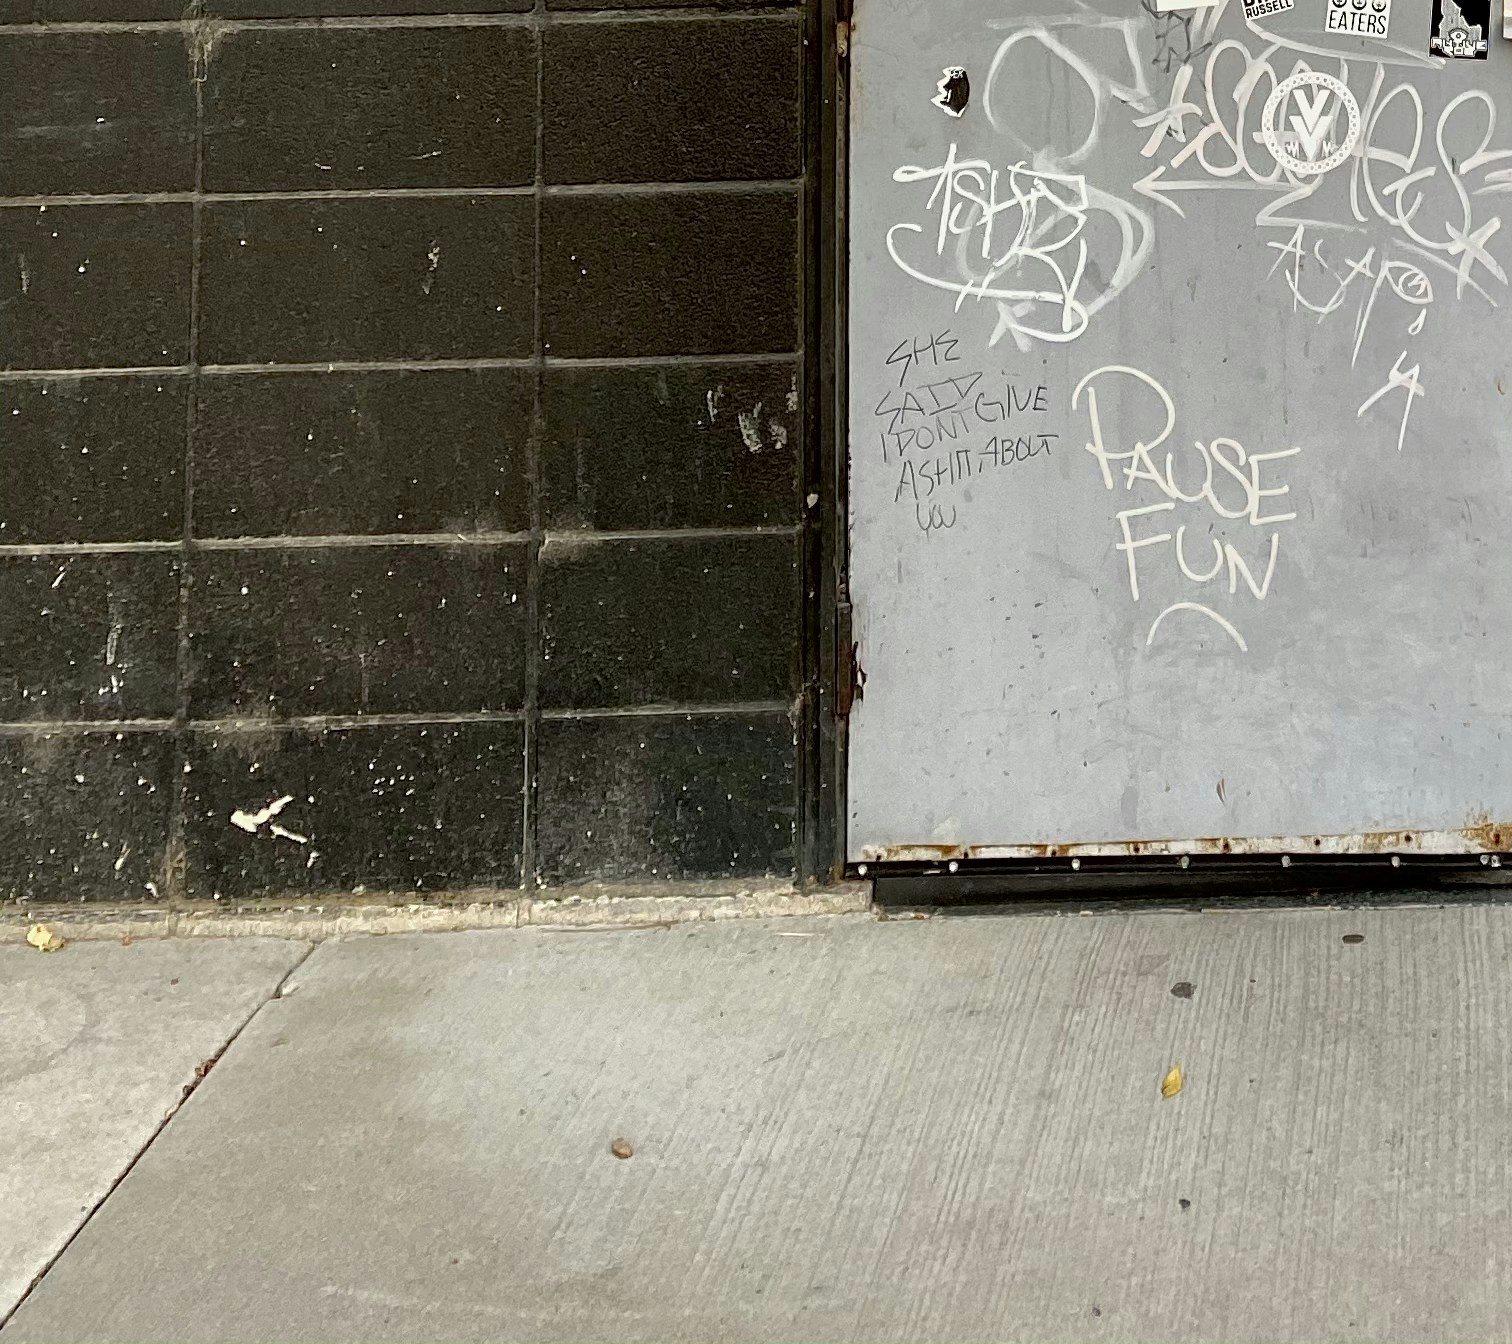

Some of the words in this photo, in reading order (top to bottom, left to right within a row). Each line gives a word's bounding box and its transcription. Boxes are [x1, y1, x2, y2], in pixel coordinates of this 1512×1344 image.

[1244, 0, 1292, 20] RUSSELL
[1329, 10, 1387, 35] EATERS
[885, 328, 961, 386] SHE
[974, 384, 1048, 424] GIVE
[1072, 365, 1301, 526] PAUSE
[1115, 502, 1280, 602] FUN
